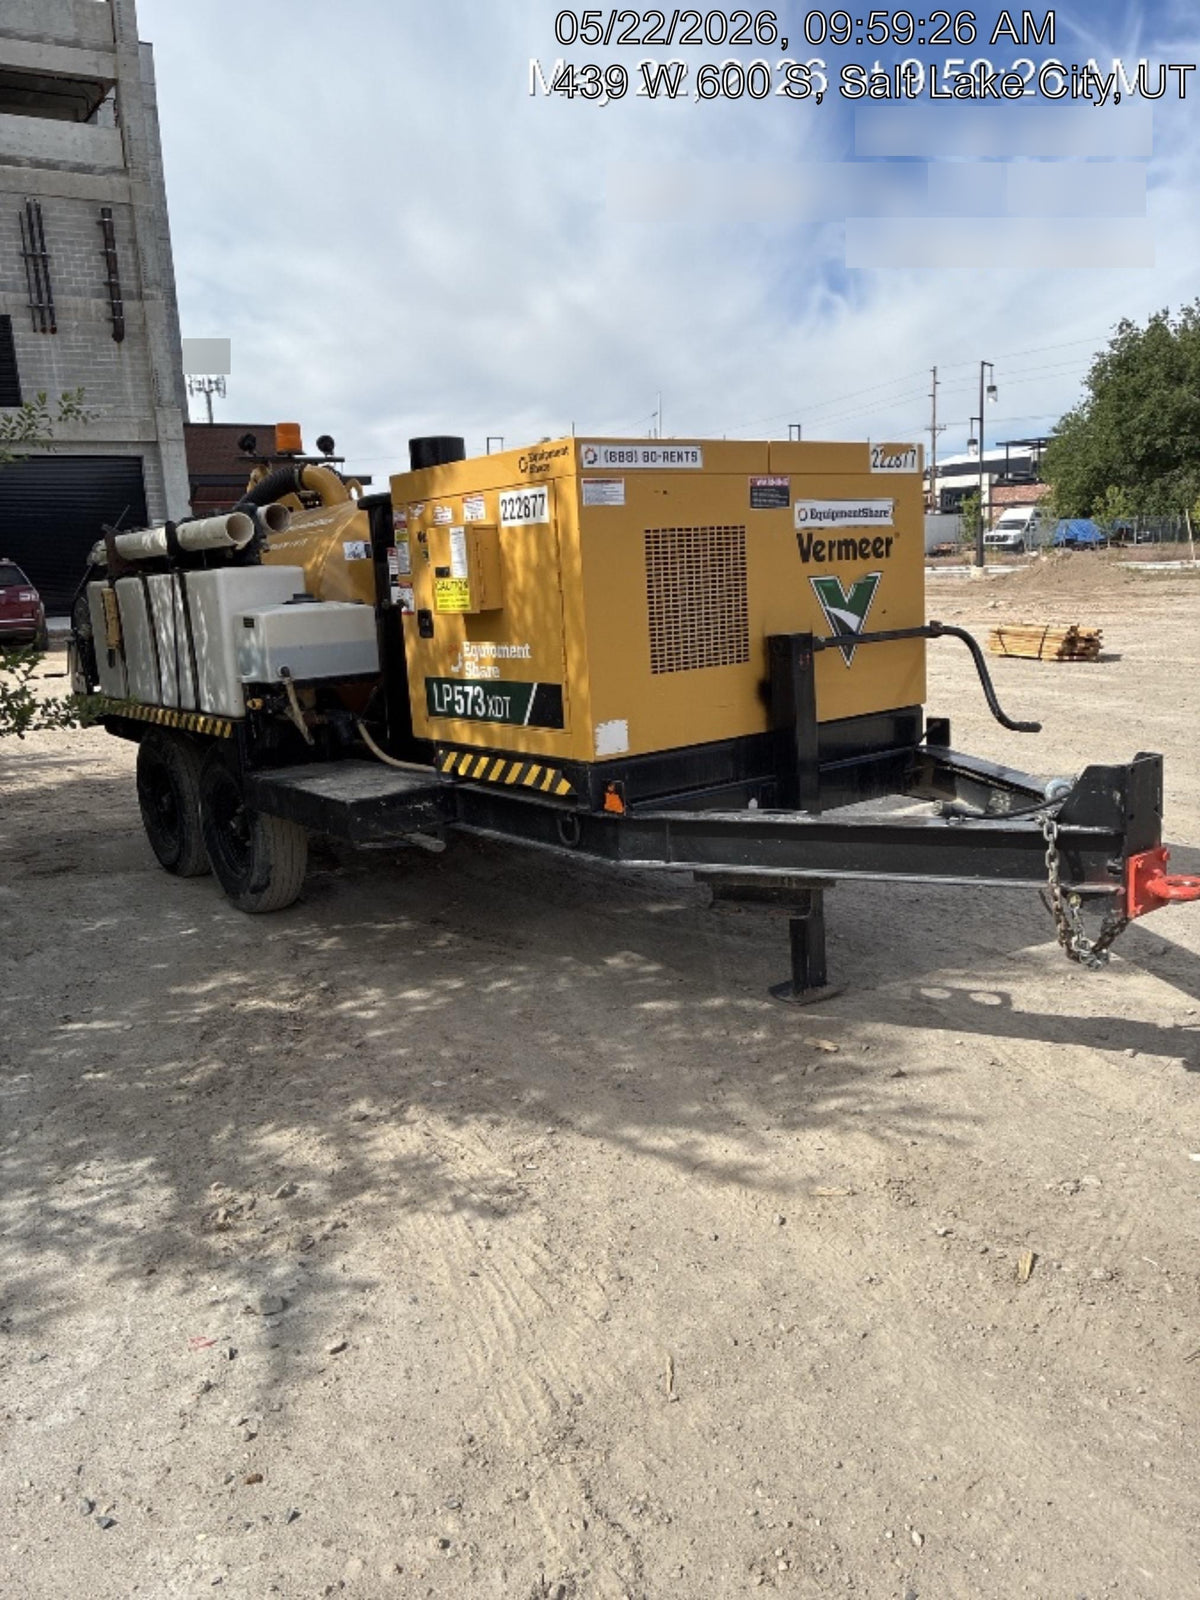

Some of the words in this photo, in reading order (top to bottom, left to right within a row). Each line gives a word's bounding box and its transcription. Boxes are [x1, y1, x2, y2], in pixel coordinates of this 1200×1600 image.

[501, 494, 546, 521] 222877
[796, 532, 894, 564] Vermeer
[462, 641, 532, 662] Equipment
[464, 661, 500, 679] Share
